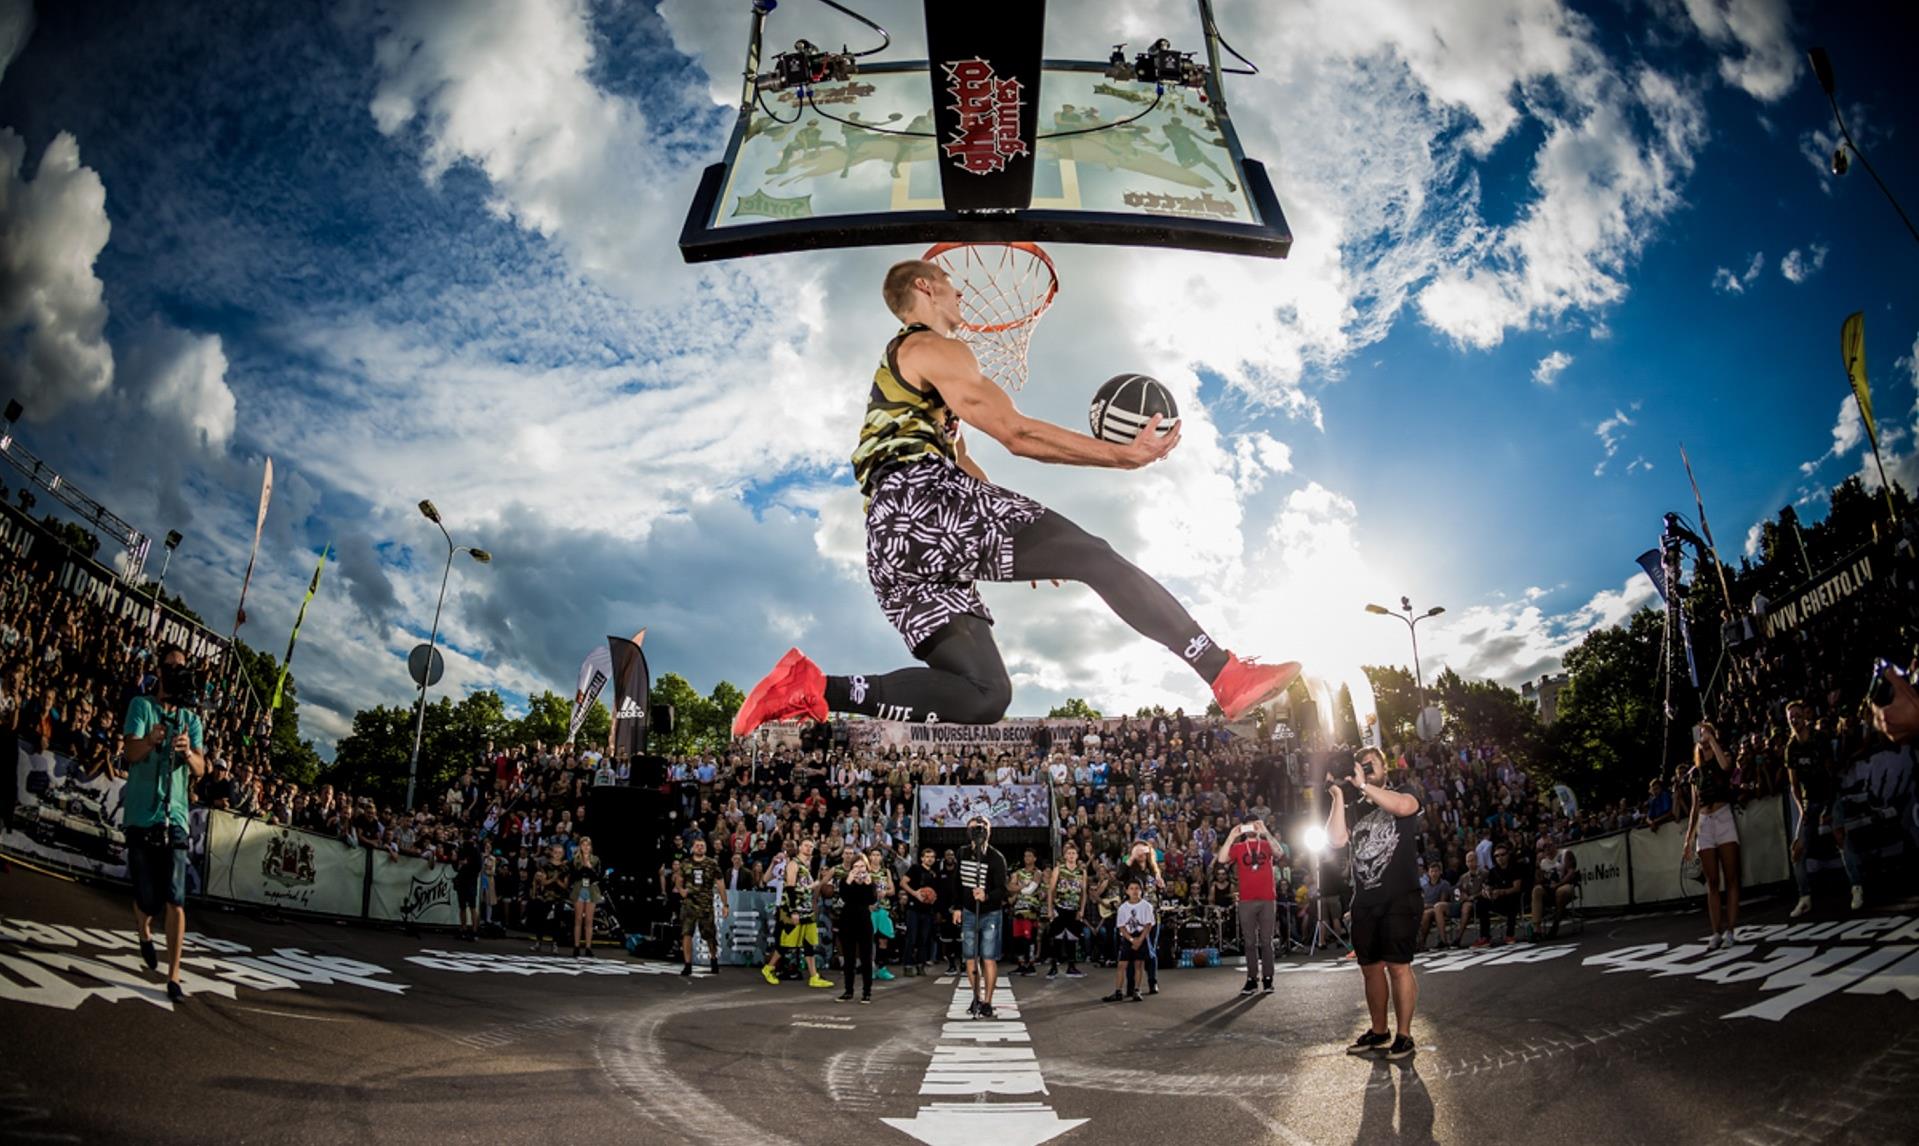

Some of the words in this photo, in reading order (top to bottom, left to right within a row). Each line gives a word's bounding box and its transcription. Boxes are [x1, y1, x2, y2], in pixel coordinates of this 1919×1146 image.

[941, 56, 1004, 175] ghetto
[994, 76, 1030, 162] games
[162, 617, 191, 650] FOR
[911, 726, 930, 741] WIN
[931, 726, 979, 742] YOURSELF
[980, 726, 1001, 741] AND
